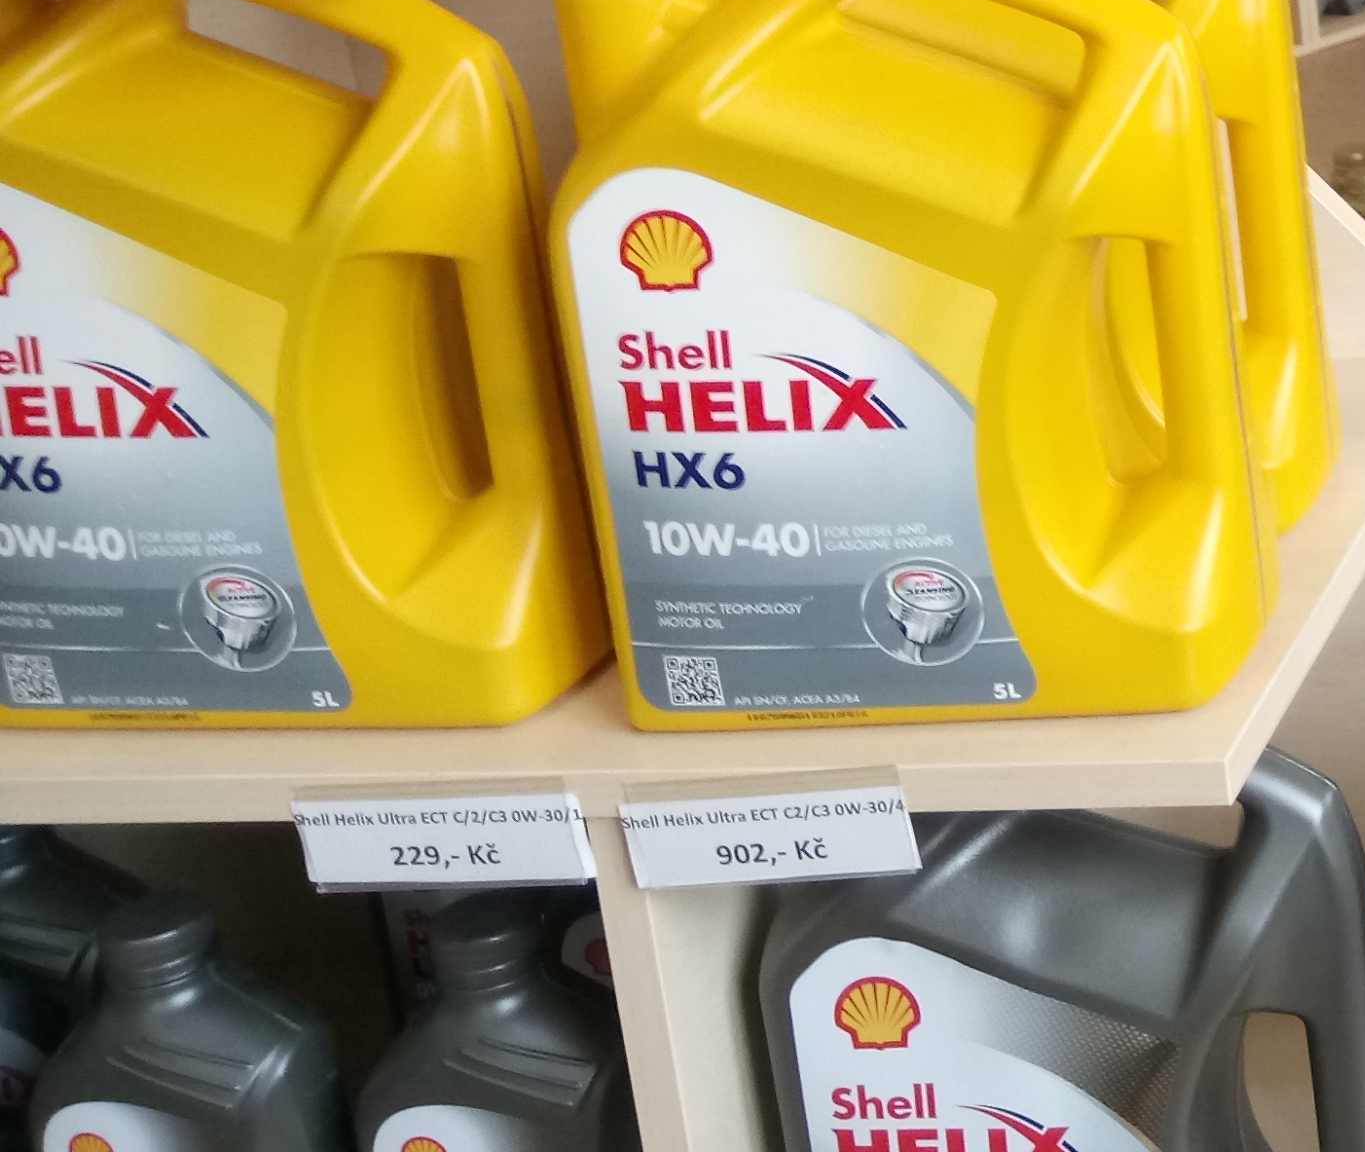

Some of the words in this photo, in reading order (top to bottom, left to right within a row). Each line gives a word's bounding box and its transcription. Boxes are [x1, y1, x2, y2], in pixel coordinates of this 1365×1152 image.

[0, 335, 44, 375] ell
[618, 330, 733, 371] Shell
[0, 385, 207, 439] ELIX
[619, 378, 905, 433] HELIX
[0, 455, 62, 494] X6
[633, 450, 746, 490] HX6
[0, 522, 126, 562] 0W-40
[643, 519, 811, 558] 10W-40
[655, 600, 716, 615] SYNTHETIC
[719, 601, 802, 616] TECHNOLOGY
[703, 618, 724, 631] OIL
[993, 682, 1022, 700] 5L
[293, 811, 330, 829] Shell
[333, 810, 374, 828] Helix
[377, 809, 417, 827] Ultra
[420, 810, 449, 826] ECT
[452, 807, 508, 828] C/2/C3
[621, 814, 659, 831] Shell
[662, 811, 705, 828] Helix
[707, 808, 749, 826] Ultra
[751, 807, 780, 823] ECT
[783, 804, 832, 822] C2/C3
[391, 844, 461, 870] 229,-
[468, 841, 502, 866] Kč
[716, 841, 788, 868] 902,-
[795, 837, 829, 862] Kč
[831, 1082, 938, 1121] Shell
